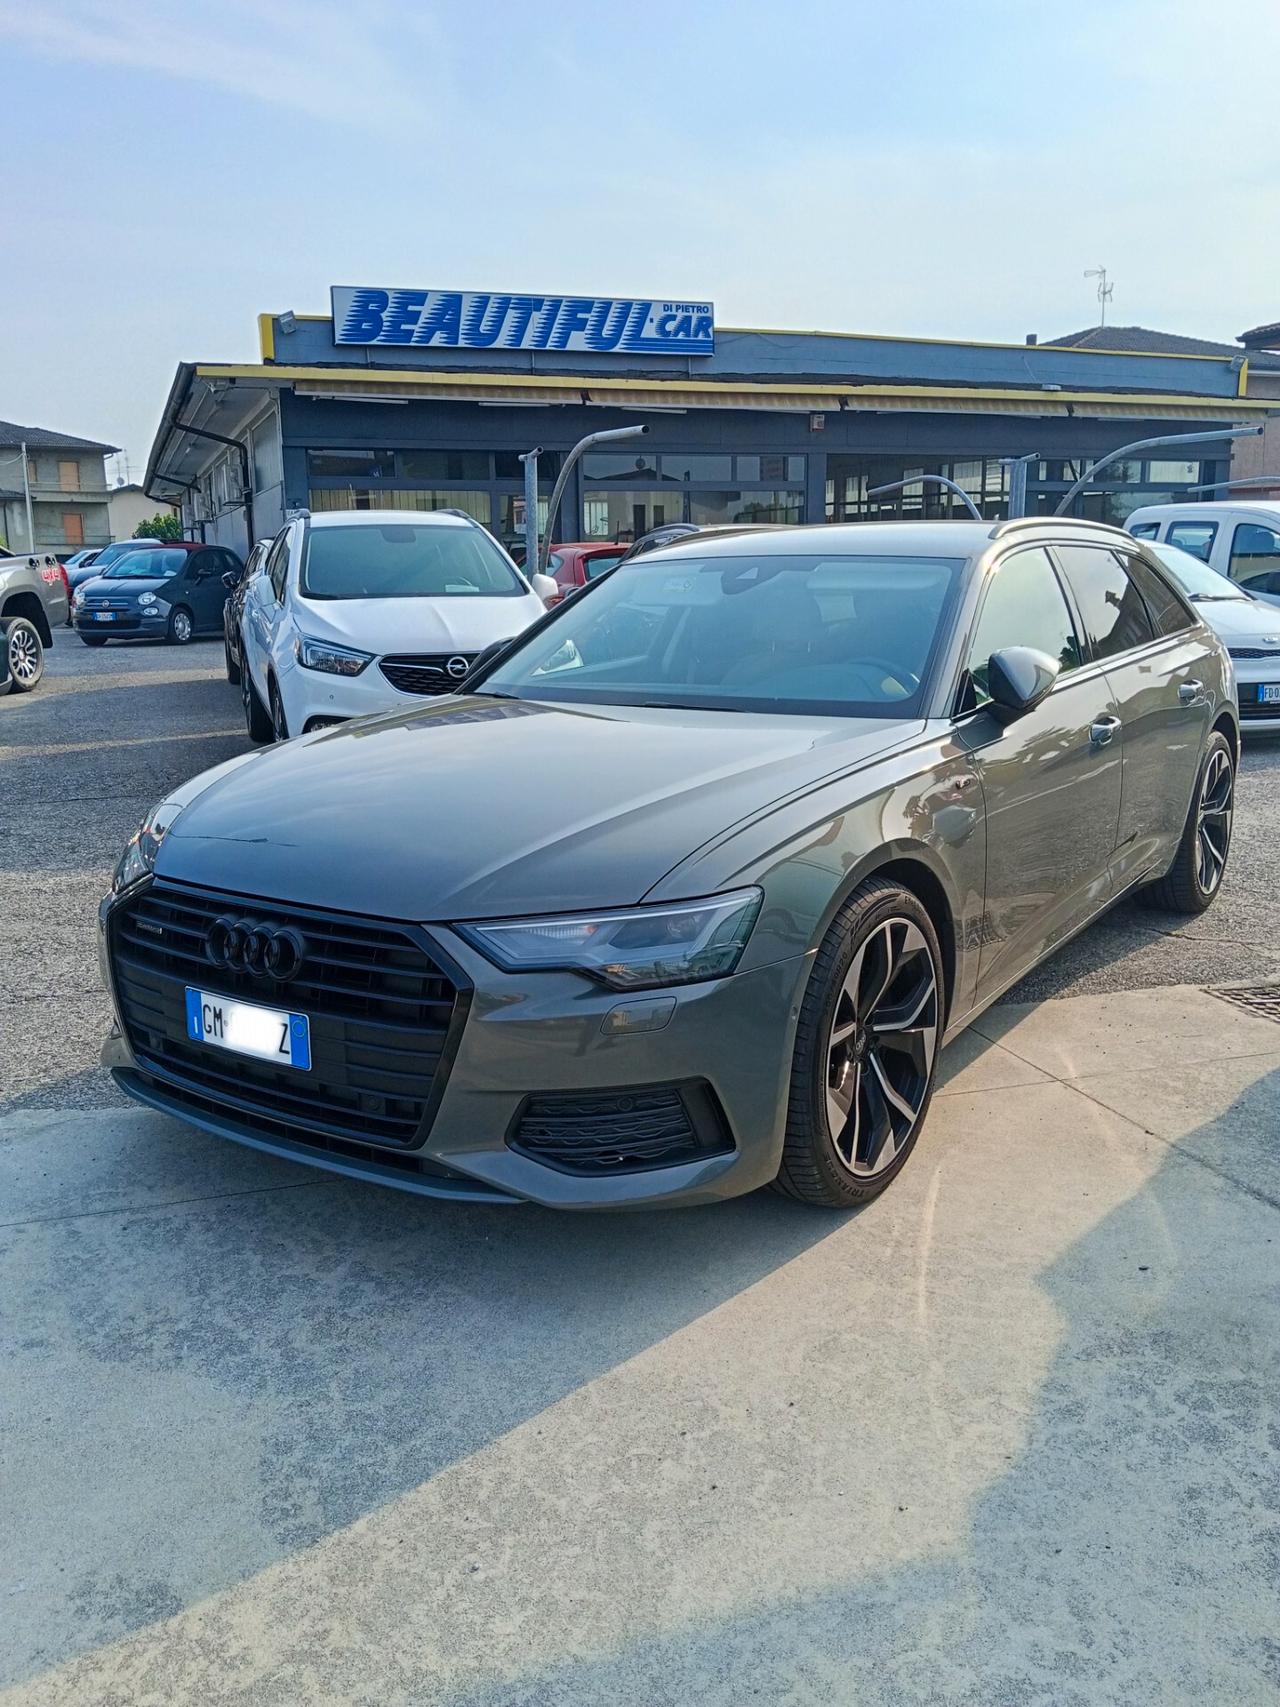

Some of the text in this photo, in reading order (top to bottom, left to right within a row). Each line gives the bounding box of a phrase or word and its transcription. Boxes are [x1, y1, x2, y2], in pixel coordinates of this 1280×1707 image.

[337, 289, 652, 351] BEAUTIFUL
[662, 303, 710, 314] DI PIETRO
[655, 314, 713, 339] CAR
